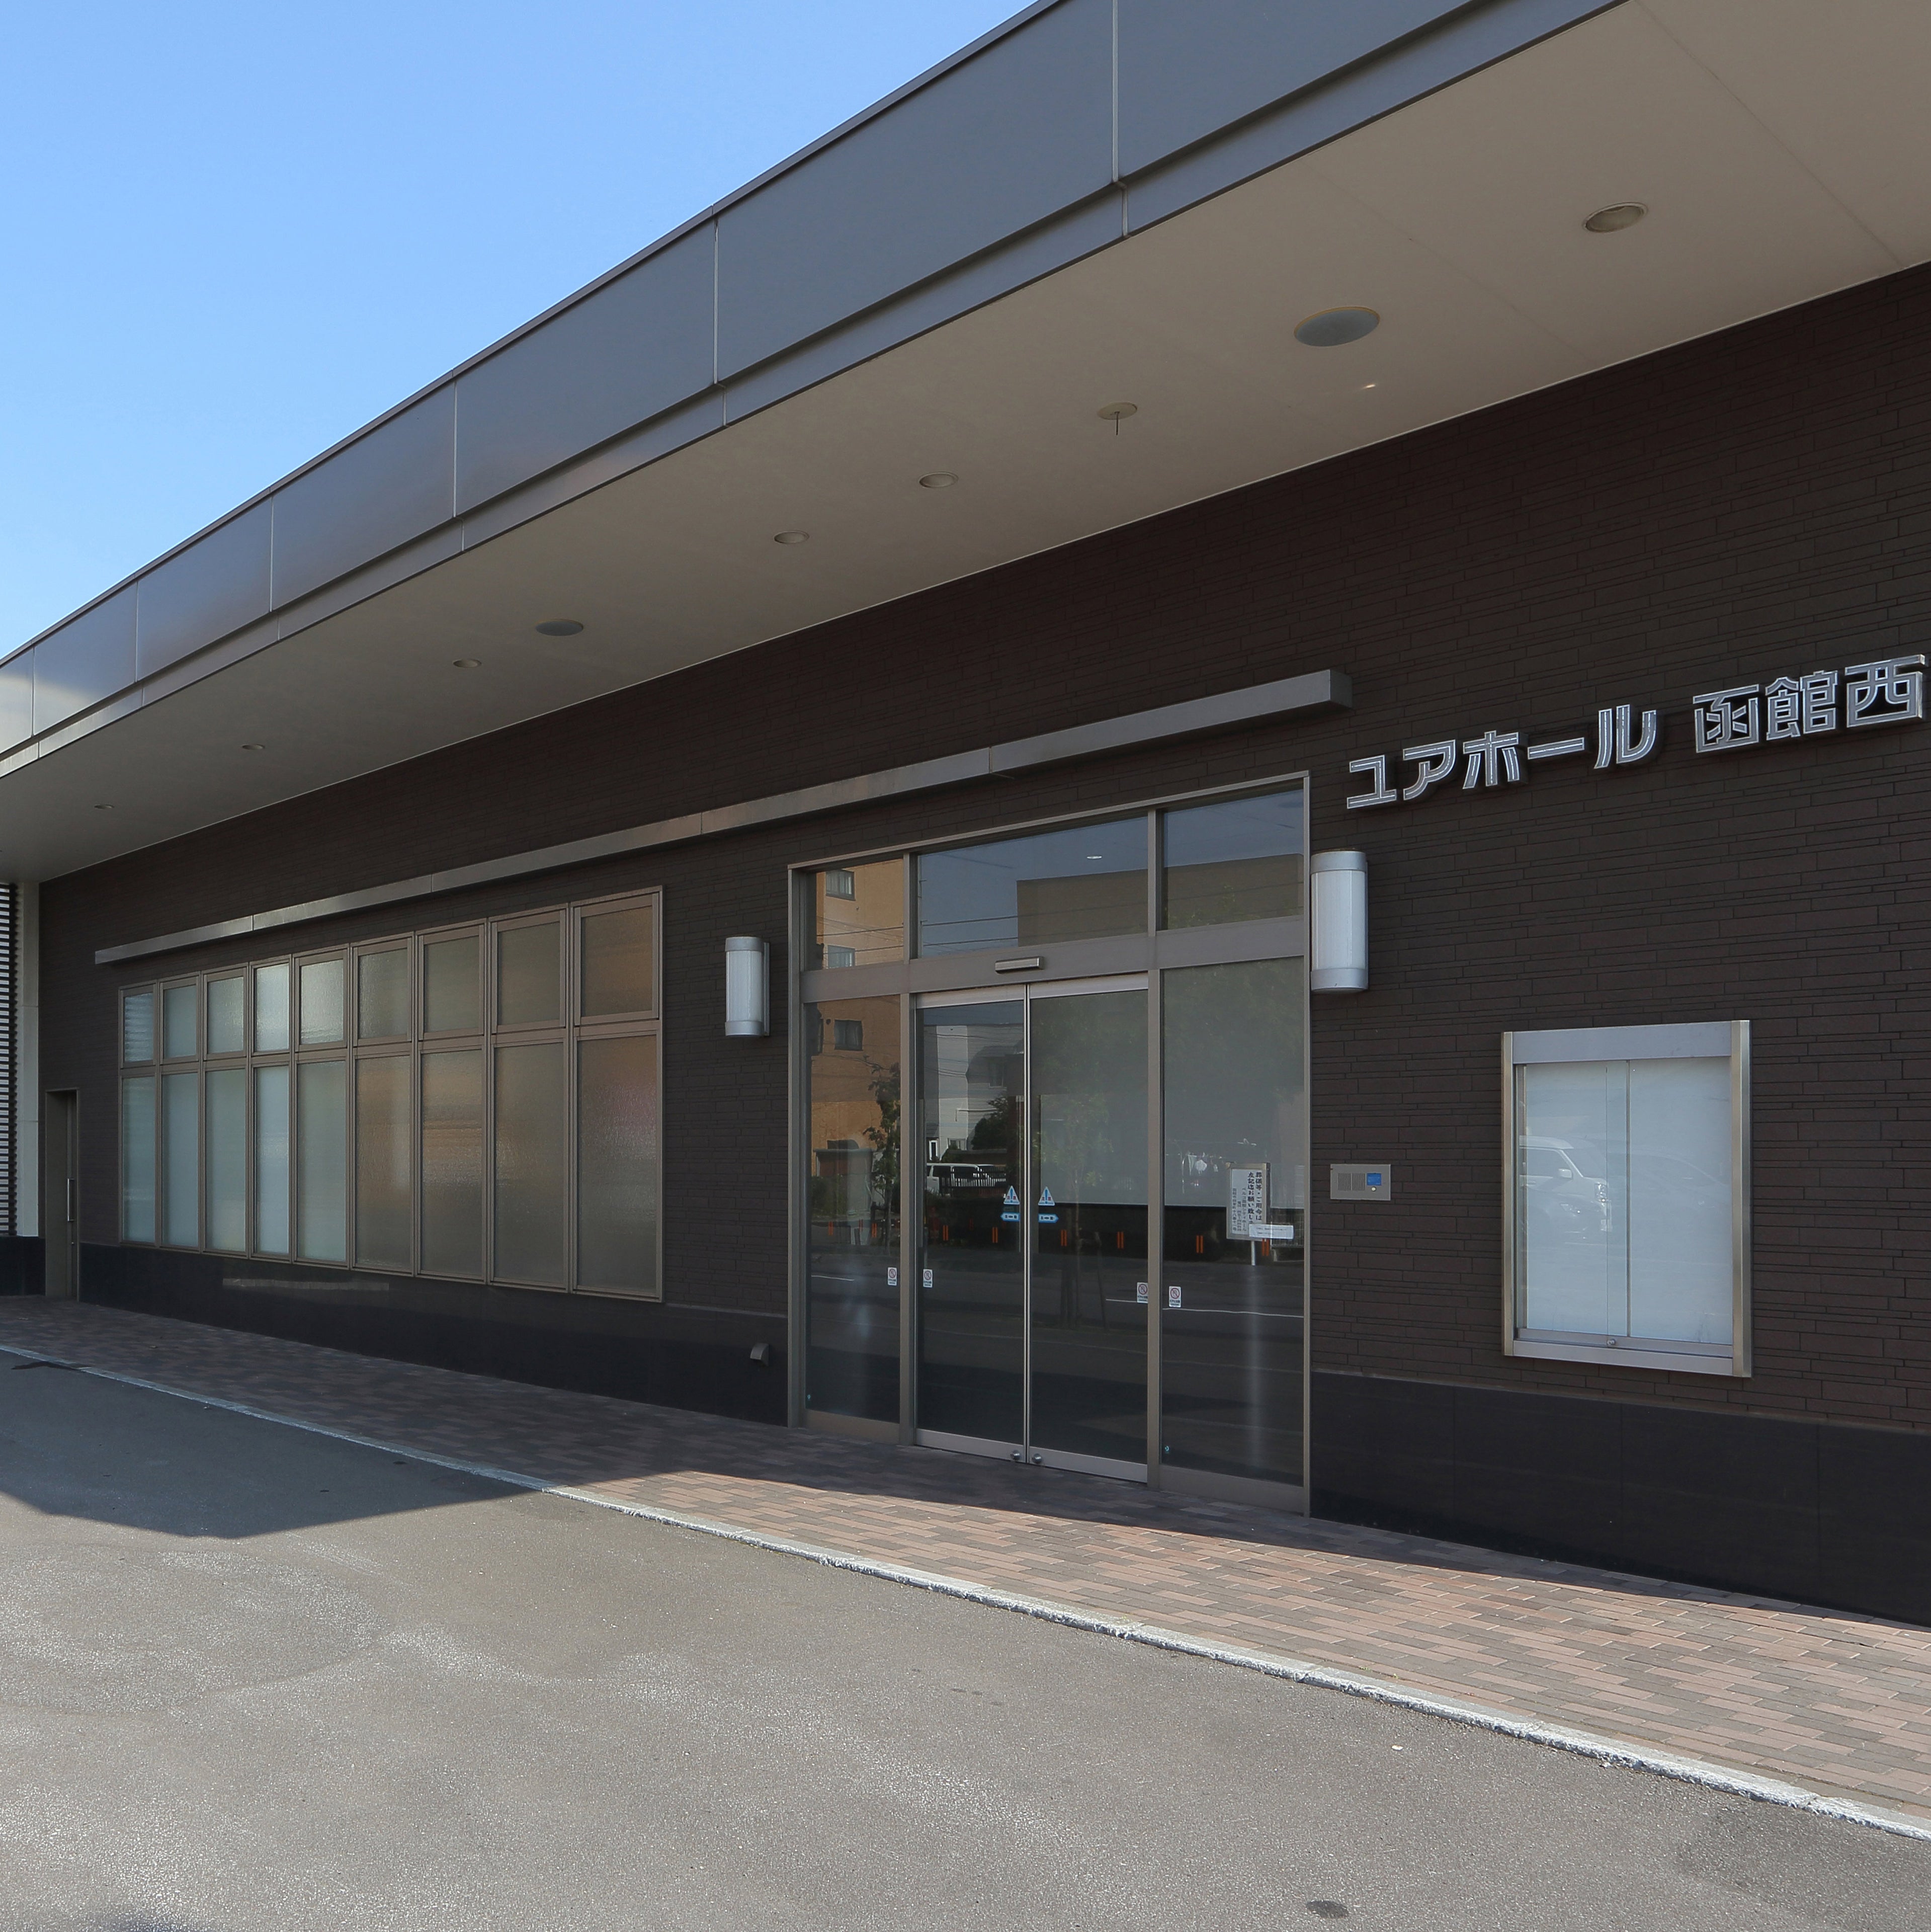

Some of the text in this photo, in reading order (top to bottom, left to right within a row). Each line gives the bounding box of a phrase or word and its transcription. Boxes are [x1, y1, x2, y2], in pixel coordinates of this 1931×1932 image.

[1347, 654, 1925, 810] ユアホール 函館西
